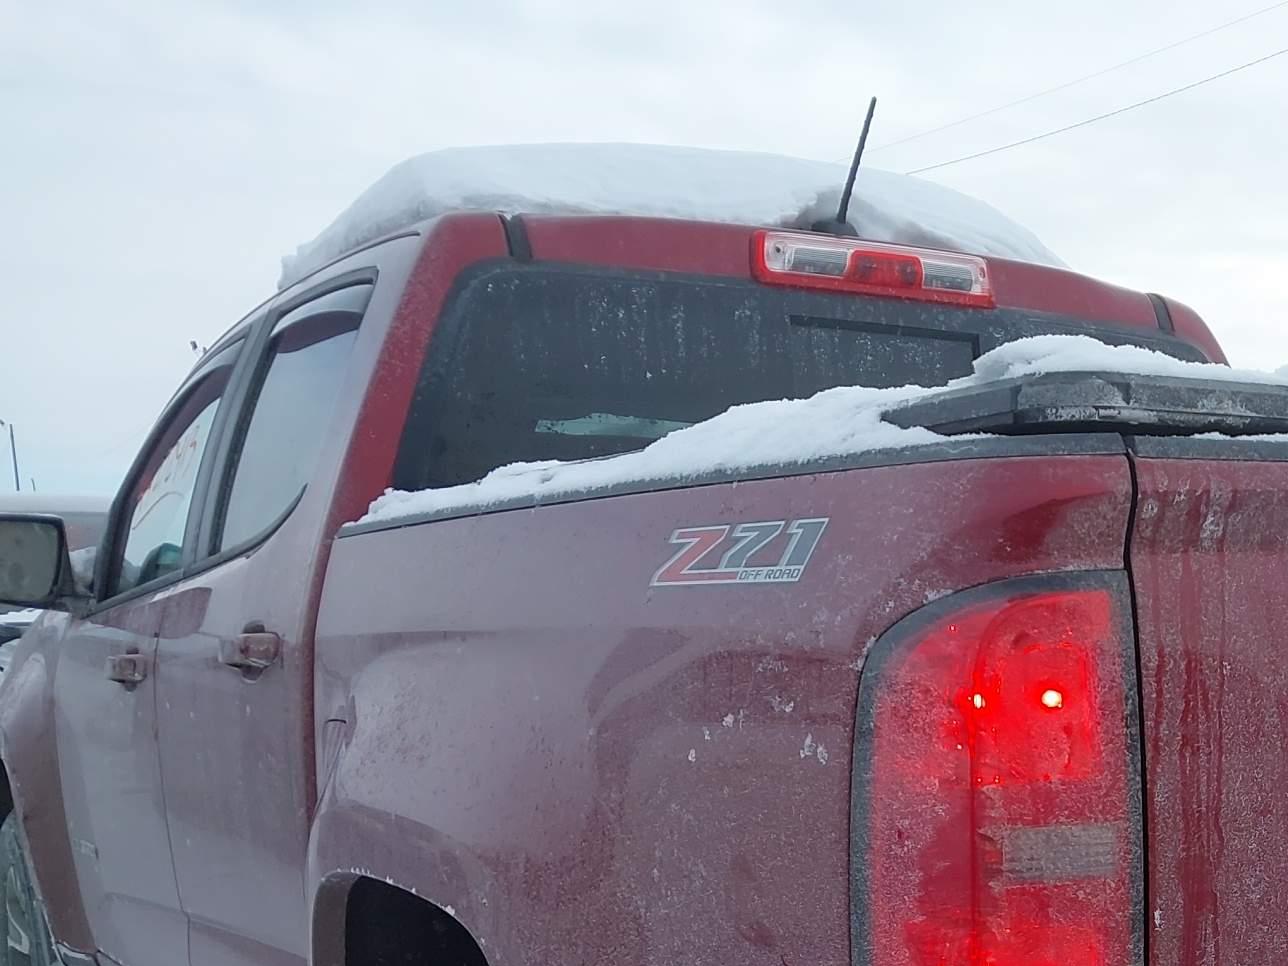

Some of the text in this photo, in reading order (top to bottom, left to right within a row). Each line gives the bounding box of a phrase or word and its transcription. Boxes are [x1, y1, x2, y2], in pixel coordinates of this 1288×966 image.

[649, 517, 830, 586] Z71
[739, 568, 801, 580] OFF ROAD
